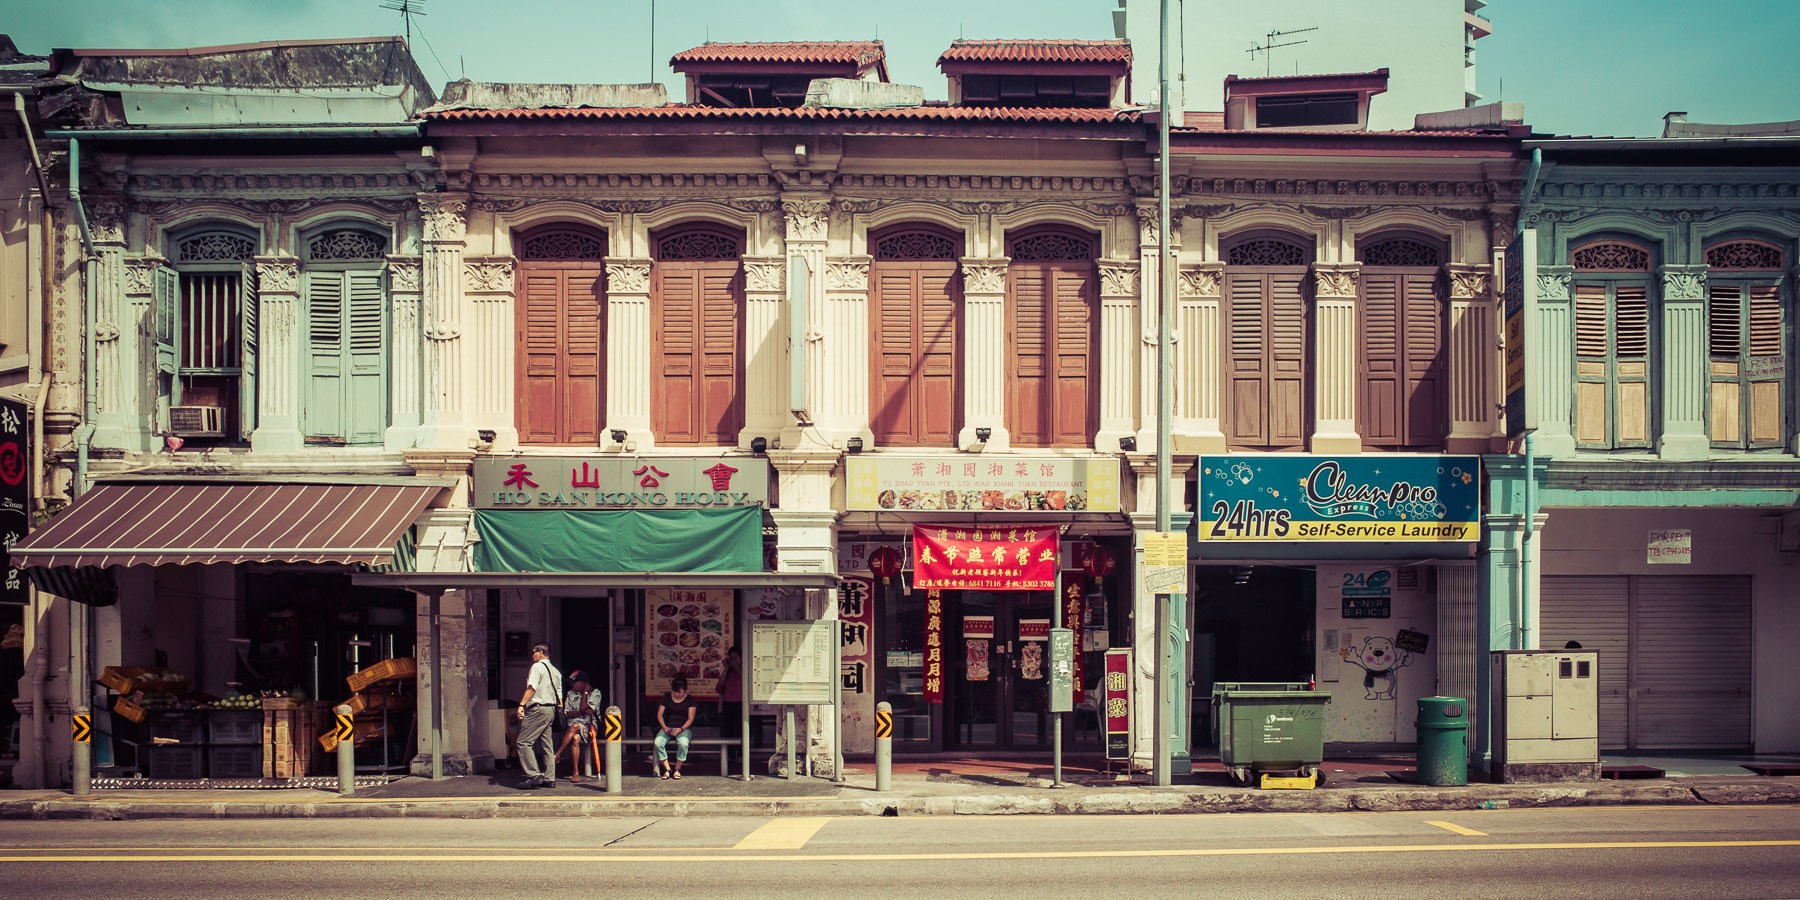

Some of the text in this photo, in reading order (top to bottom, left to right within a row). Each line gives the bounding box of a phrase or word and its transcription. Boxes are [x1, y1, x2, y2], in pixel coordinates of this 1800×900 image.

[1507, 344, 1523, 366] Service
[1506, 365, 1524, 390] Laundry
[1, 406, 21, 435] 松
[503, 462, 739, 491] 禾山公會
[911, 462, 1055, 478] 萧湘园湘菜馆
[2, 497, 24, 509] Zoom
[493, 492, 749, 506] HO SAN KONG HOEY
[1210, 499, 1291, 538] 24hrs
[1327, 504, 1370, 516] Express
[1298, 523, 1469, 540] Self-Service Laundry
[918, 545, 1055, 565] 春节照常营业
[986, 579, 1002, 587] 7116
[1040, 579, 1055, 587] 3786
[1343, 572, 1366, 586] 24
[1108, 671, 1128, 718] 湘菜
